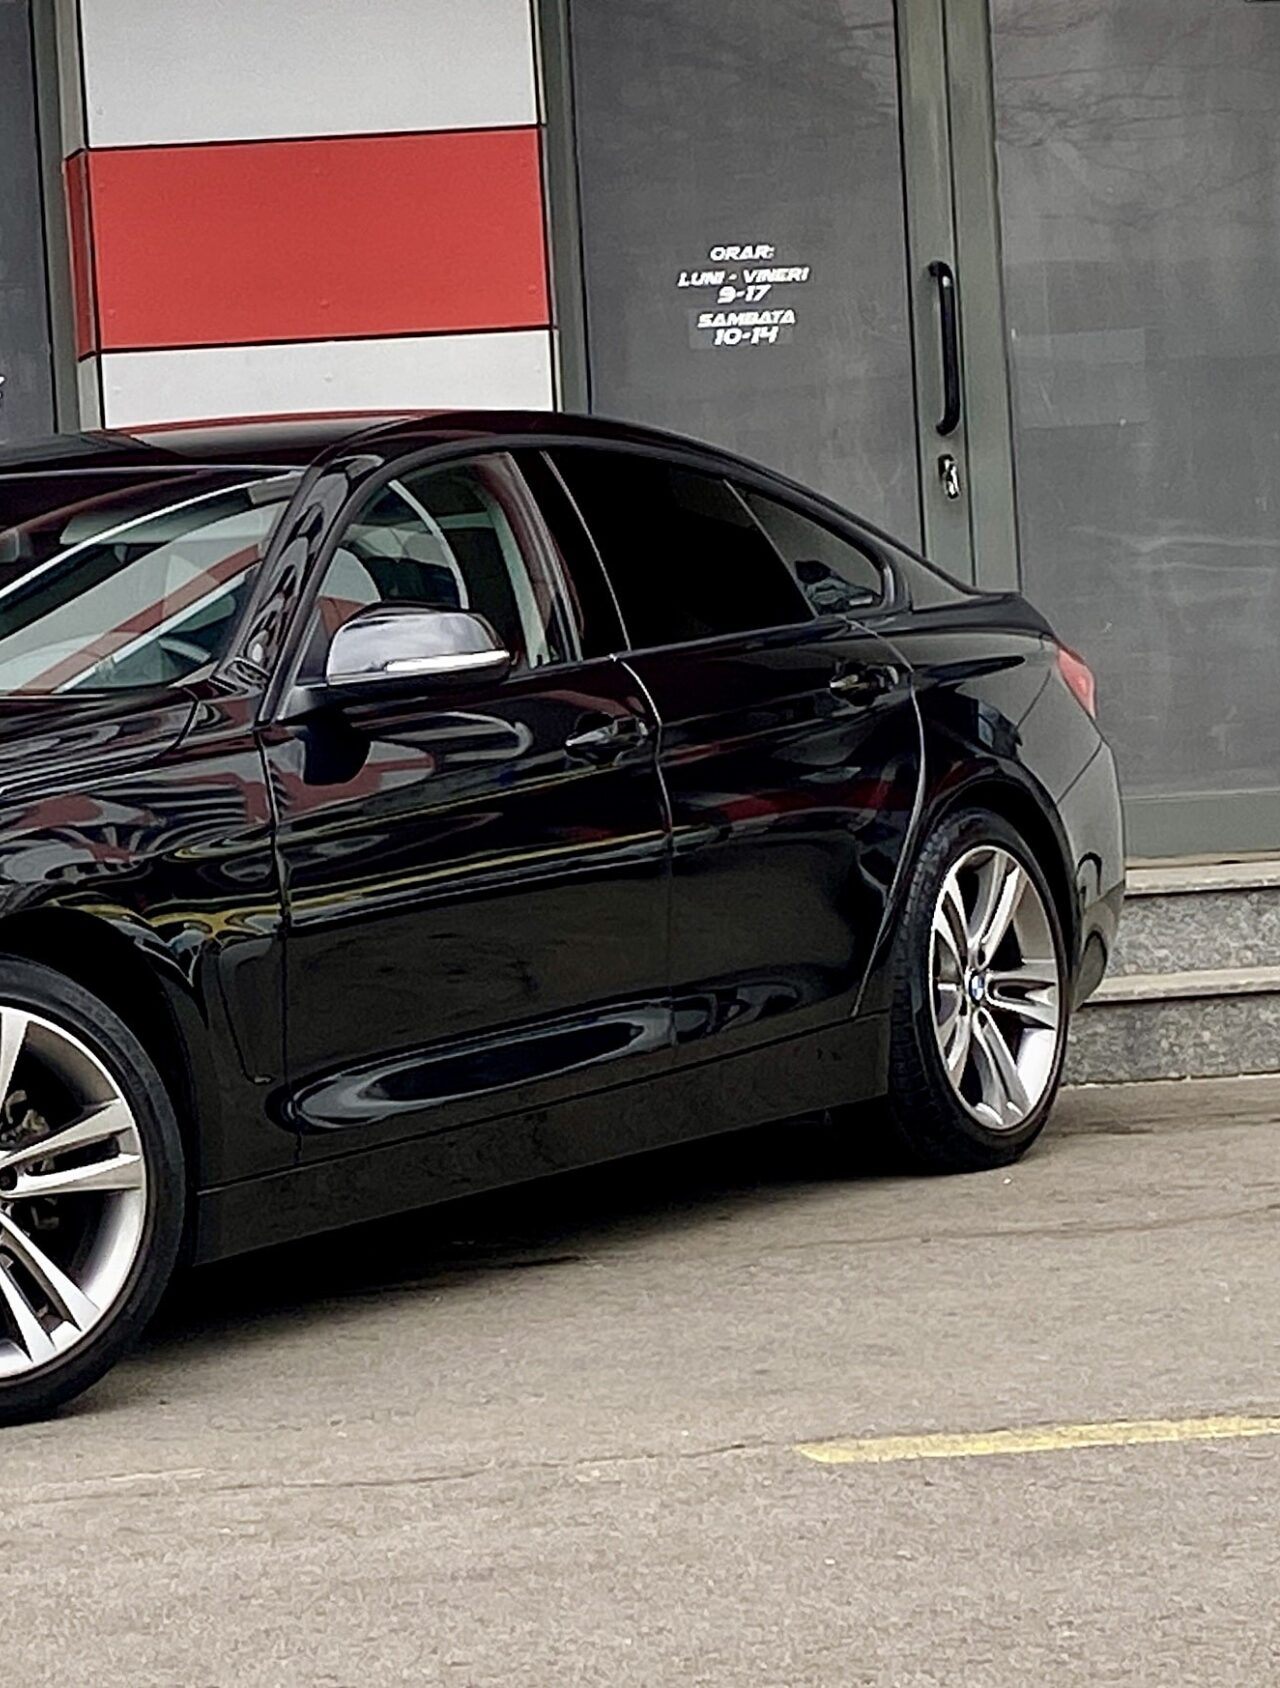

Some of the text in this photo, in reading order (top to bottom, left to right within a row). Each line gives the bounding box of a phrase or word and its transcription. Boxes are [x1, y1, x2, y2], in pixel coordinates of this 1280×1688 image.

[710, 244, 776, 262] ORAR:
[677, 270, 726, 288] LUNI
[742, 266, 811, 284] VINERI
[717, 284, 772, 304] 9-17
[697, 309, 797, 328] SAMBATA
[713, 326, 779, 346] 10-14
